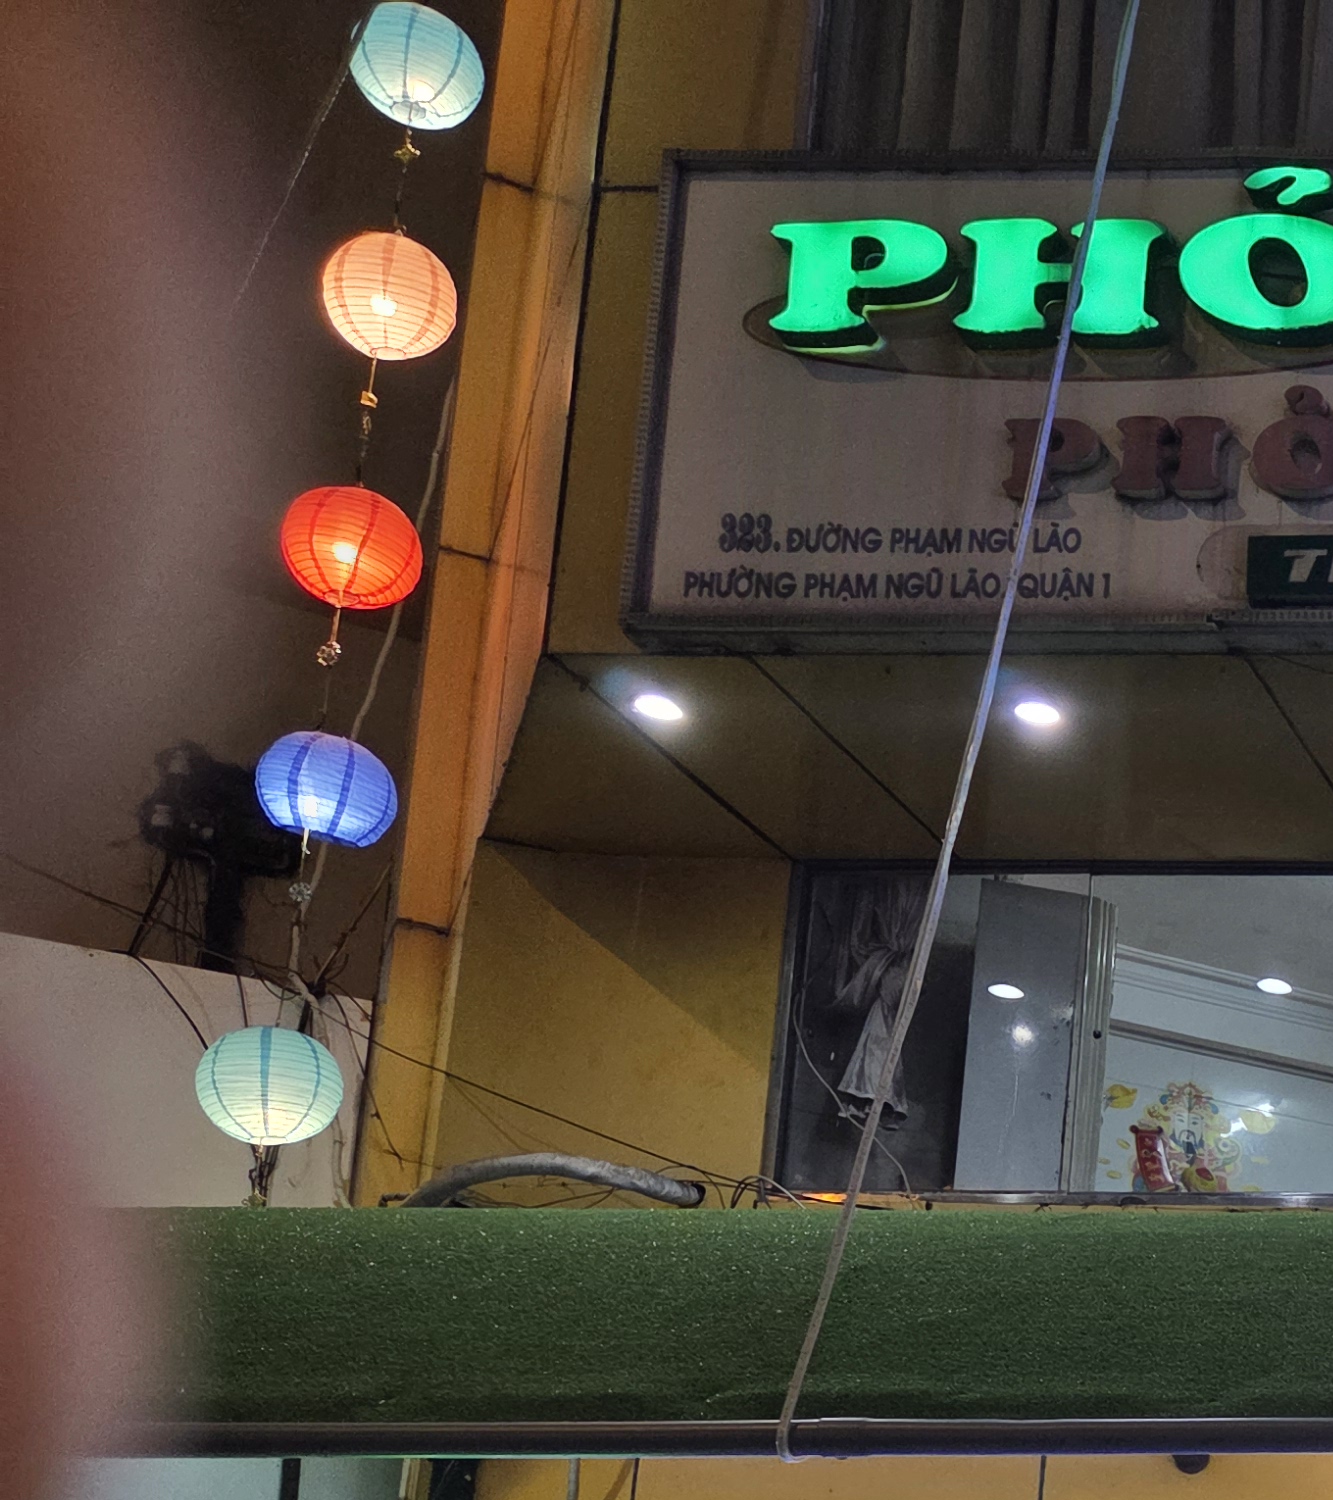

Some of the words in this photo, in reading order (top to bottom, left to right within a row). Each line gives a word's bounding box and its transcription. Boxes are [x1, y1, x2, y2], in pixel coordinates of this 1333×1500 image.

[889, 526, 962, 558] PHẠM
[1032, 521, 1082, 554] LÃO
[683, 564, 797, 600] PHƯỜNG
[803, 571, 879, 602] PHẠM
[884, 567, 943, 600] NGŨ
[1017, 566, 1095, 601] QUẬN
[1101, 573, 1111, 598] 1
